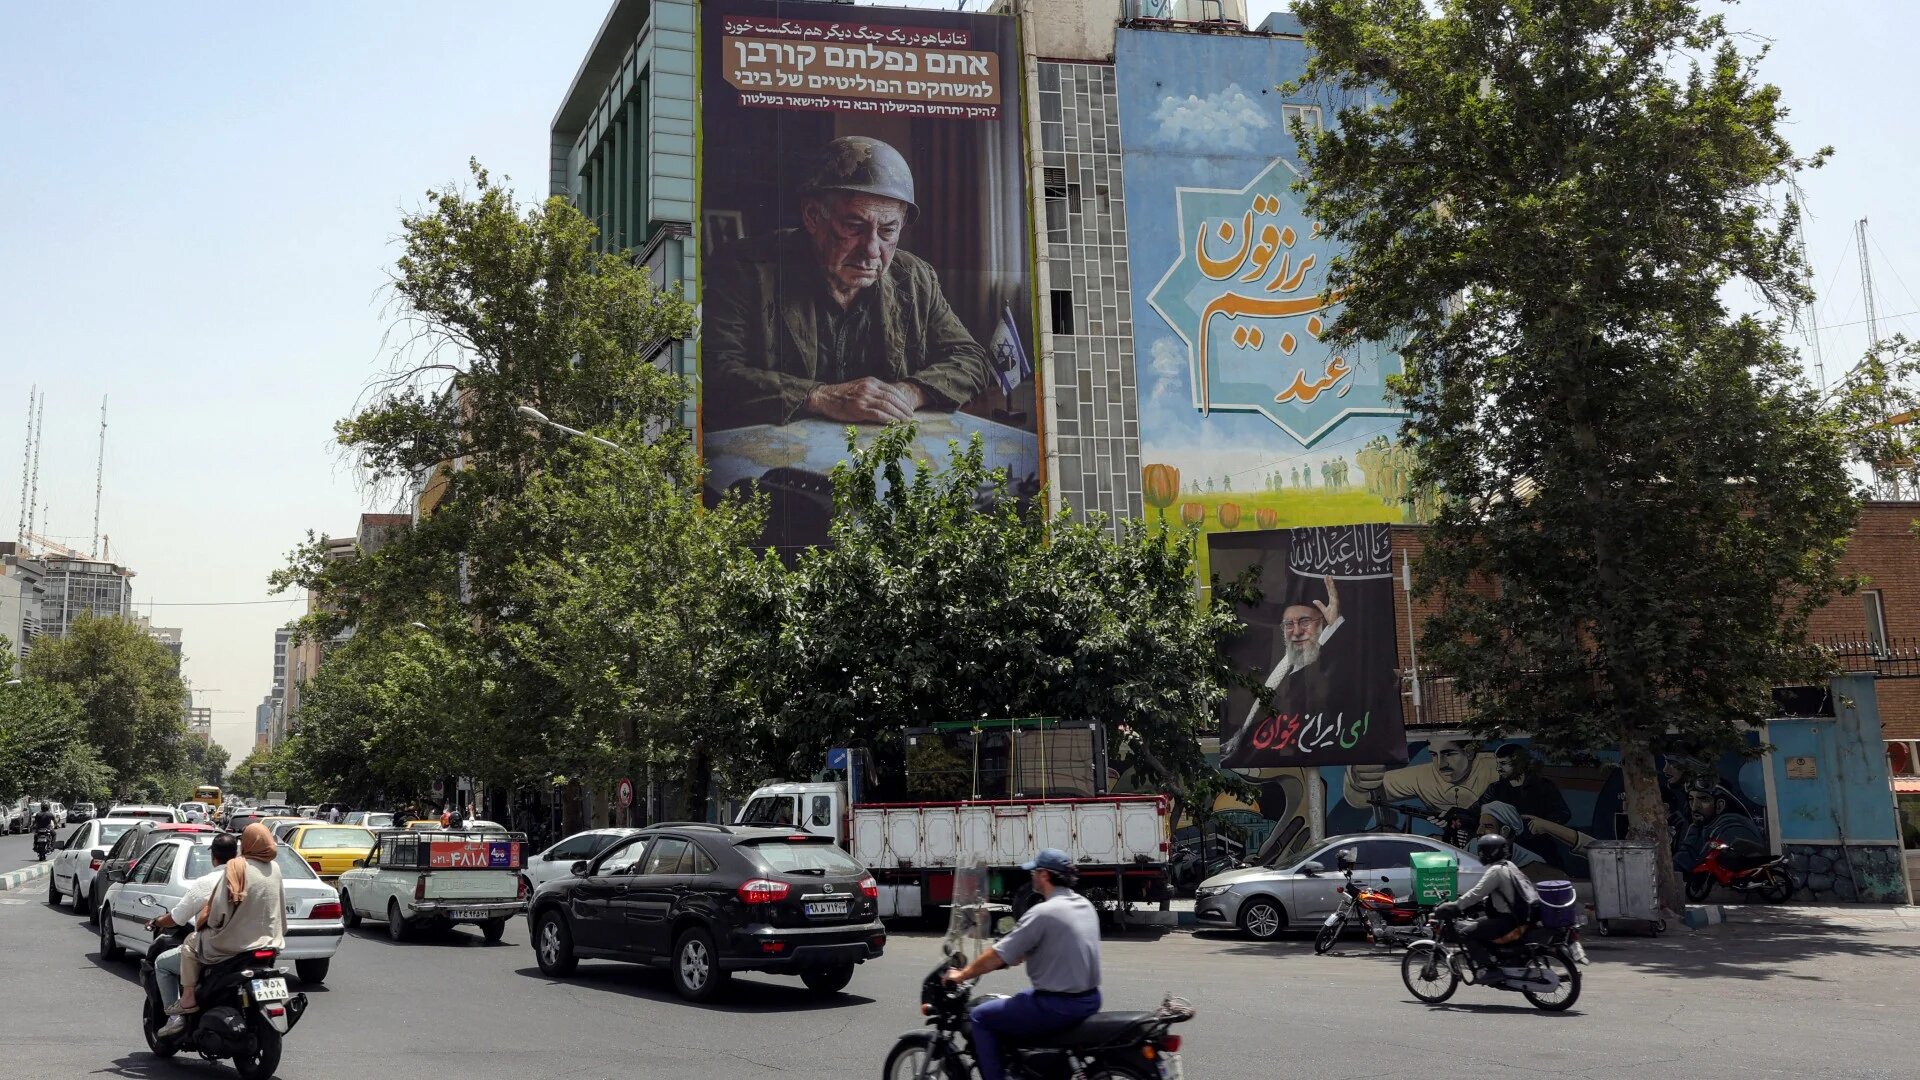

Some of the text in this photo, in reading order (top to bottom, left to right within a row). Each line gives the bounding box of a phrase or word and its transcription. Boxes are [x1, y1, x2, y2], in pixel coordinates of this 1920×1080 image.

[725, 19, 967, 47] نتانیاهو در یک جنگ دیگر هم شکست خورد
[734, 41, 990, 76] אתם נפלתם קורבן
[734, 68, 993, 99] למשחקים הפוליטיים של ביבי
[741, 92, 784, 105] בשלטון
[785, 96, 830, 108] להישאר
[832, 99, 851, 109] כדי
[853, 101, 878, 111] הבא
[880, 100, 925, 114] הכישלון
[927, 104, 964, 116] יתרחש
[1252, 711, 1370, 753] ای ایران بخوان
